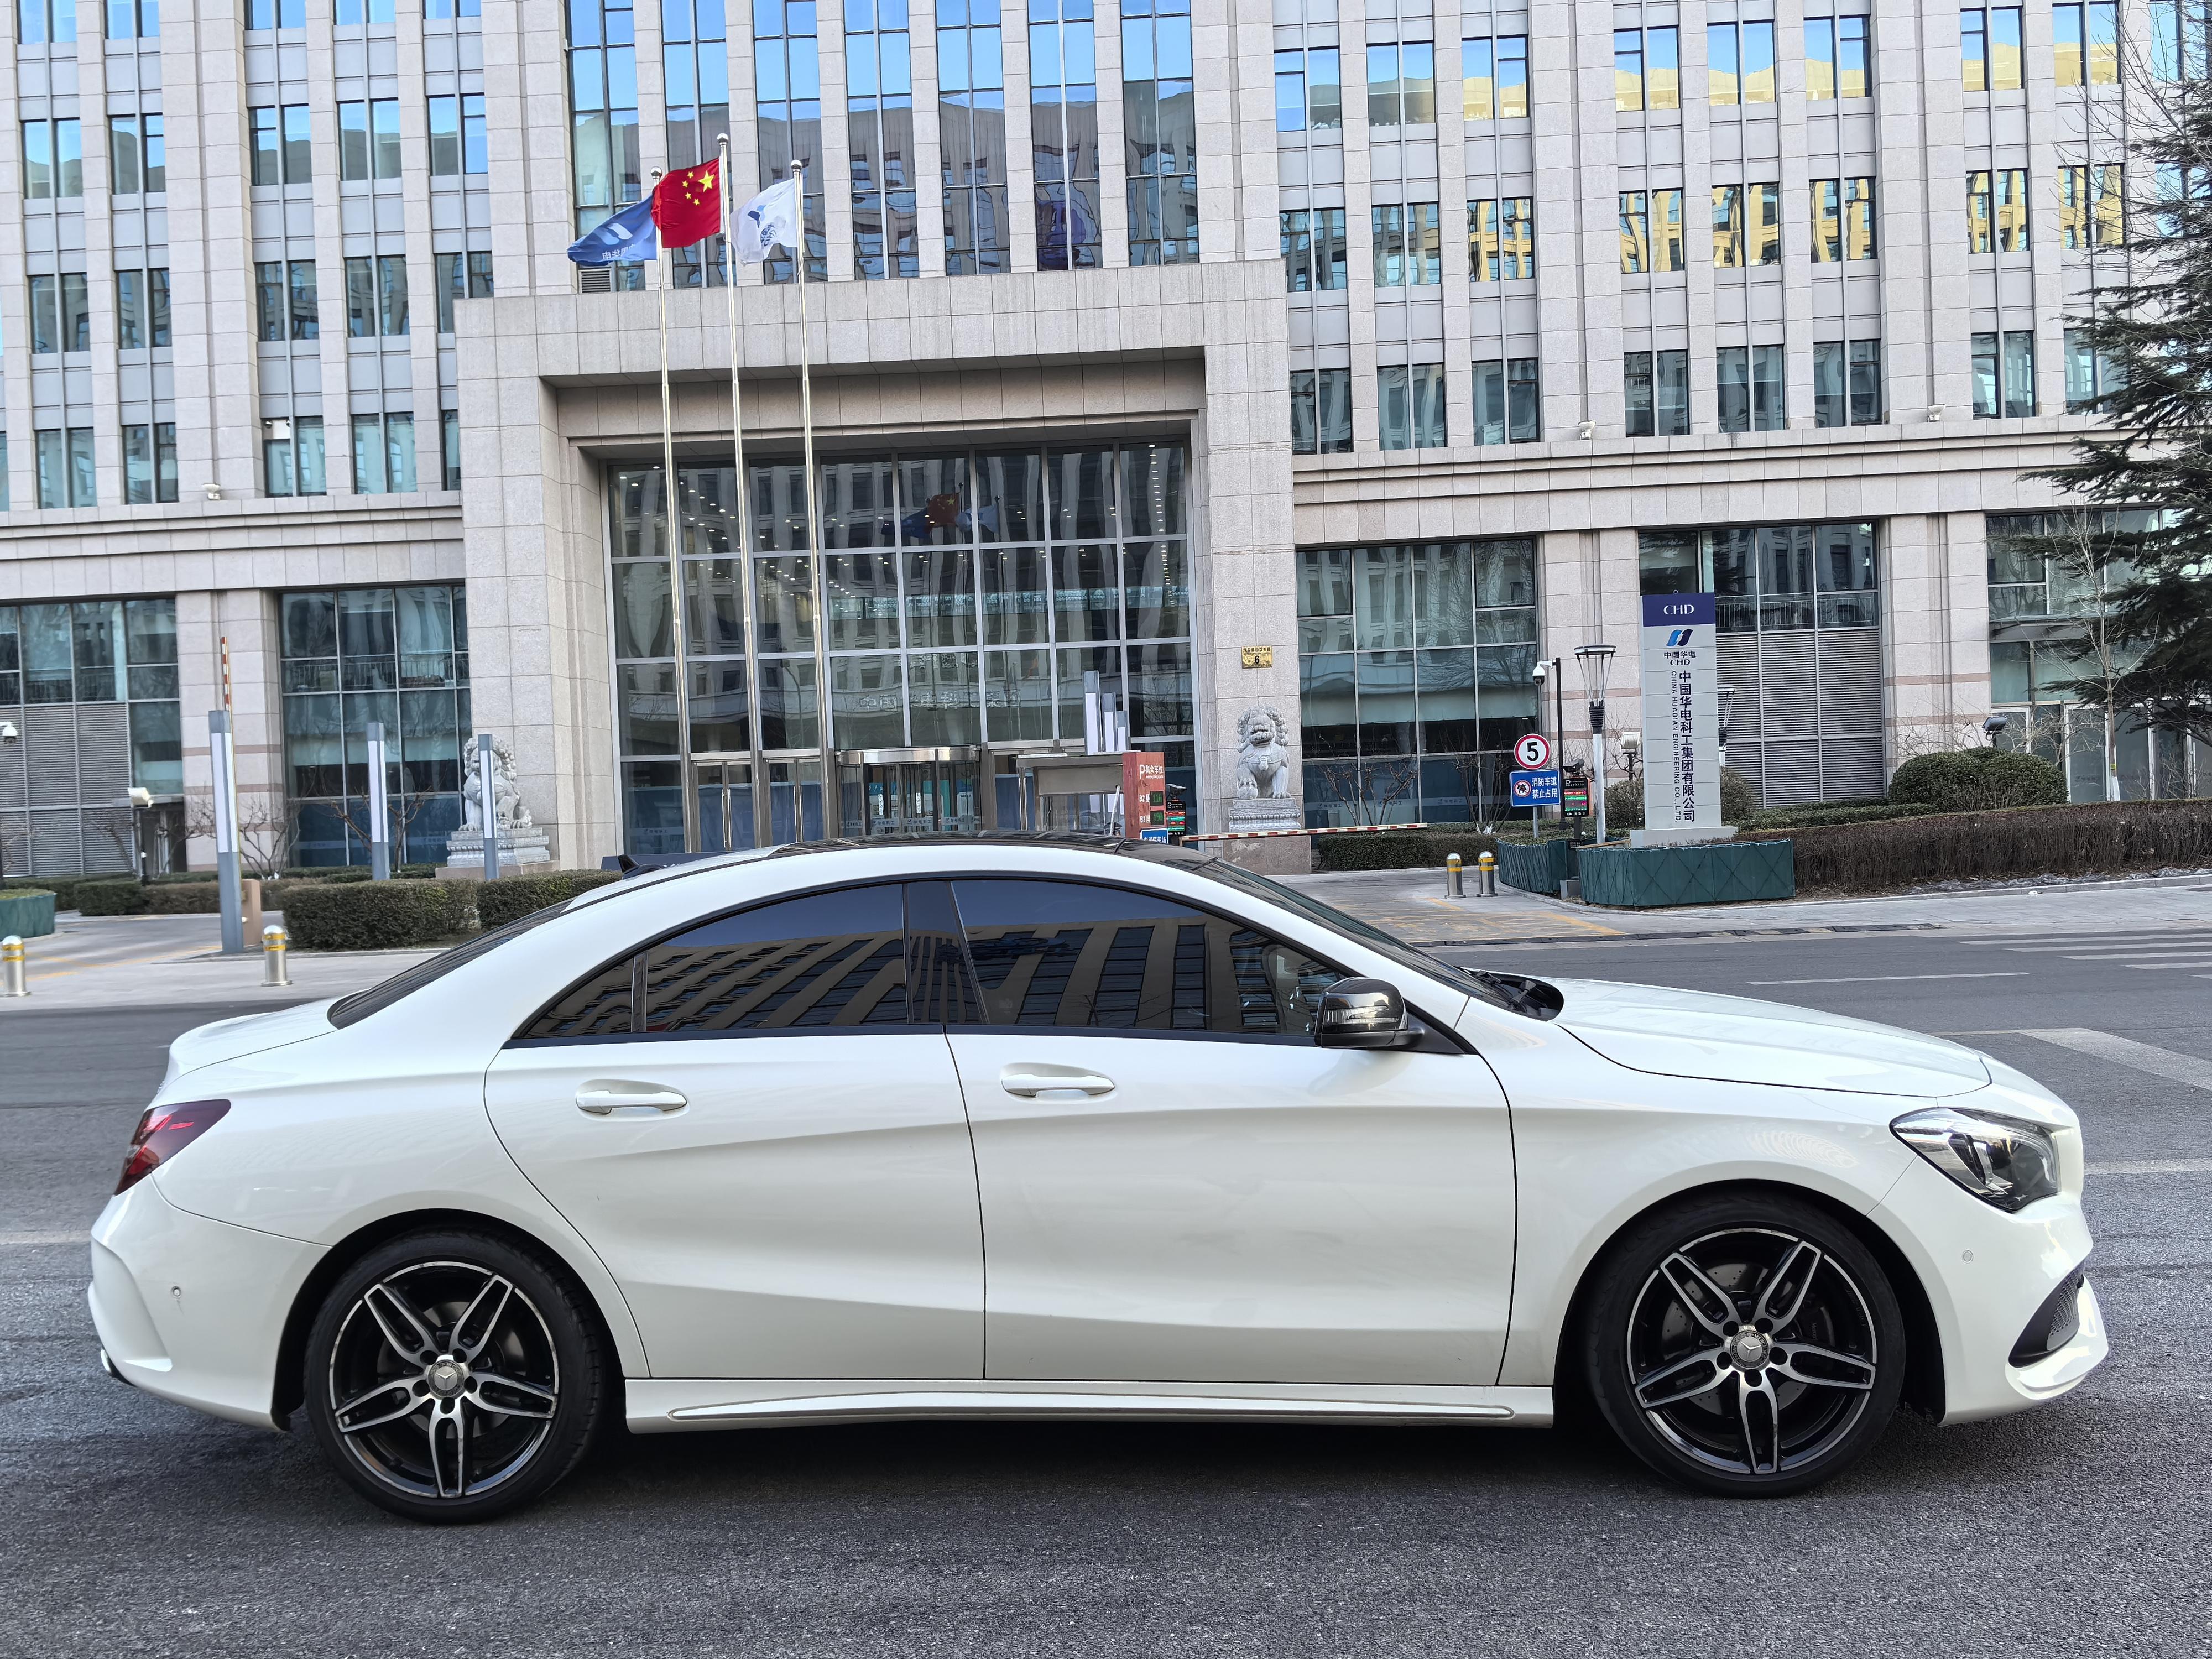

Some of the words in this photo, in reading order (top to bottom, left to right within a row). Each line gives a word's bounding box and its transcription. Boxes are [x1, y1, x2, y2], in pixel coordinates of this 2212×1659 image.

[1663, 604, 1694, 615] CHD
[1254, 655, 1260, 664] 6
[1664, 650, 1696, 659] 中国华电
[1526, 742, 1539, 761] 5
[1679, 670, 1695, 822] 中国华电科工集团有限公司
[1532, 776, 1557, 786] 消防车道
[1532, 788, 1558, 799] 禁止占用
